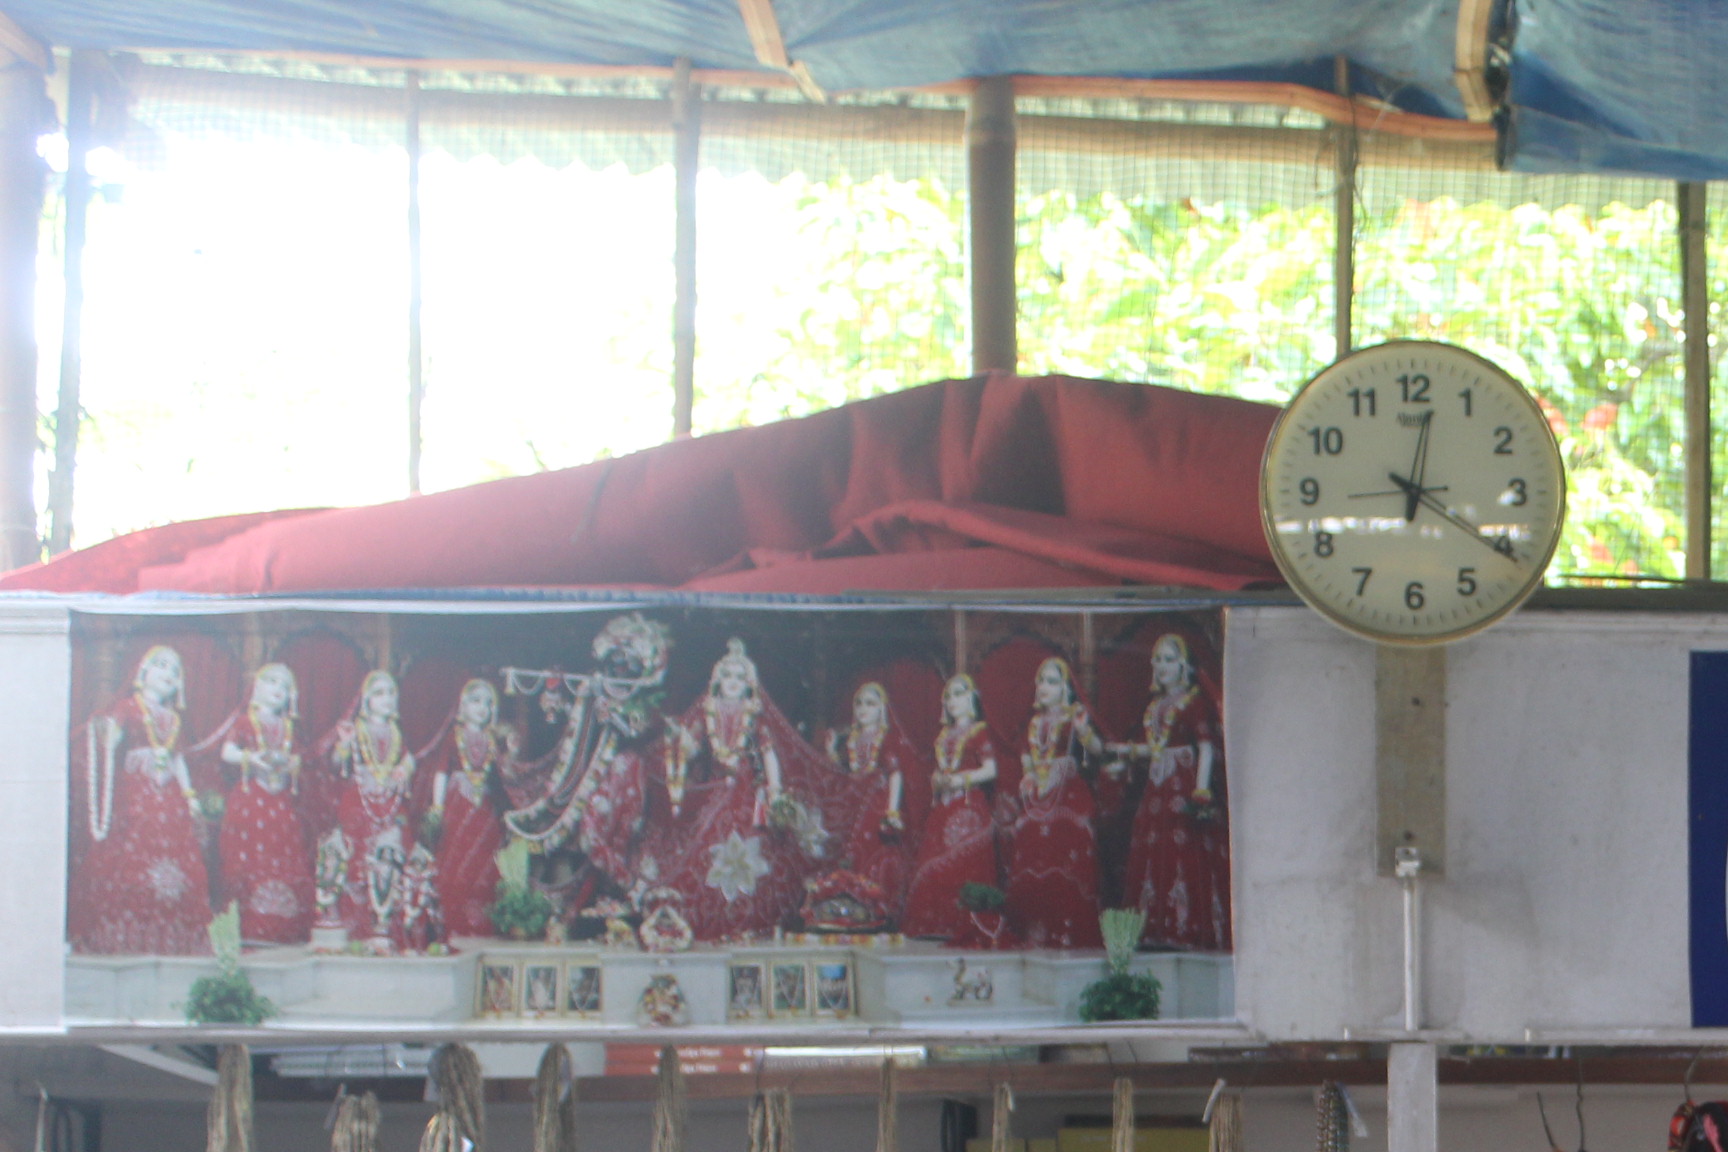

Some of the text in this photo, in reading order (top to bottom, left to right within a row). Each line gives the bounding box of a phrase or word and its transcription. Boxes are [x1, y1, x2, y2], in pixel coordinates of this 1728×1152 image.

[1349, 389, 1376, 417] 11
[1398, 375, 1430, 403] 12
[1460, 389, 1472, 417] 1
[1310, 427, 1344, 455] 10
[1494, 427, 1513, 455] 2
[1300, 478, 1320, 506] 9
[1509, 478, 1528, 507] 3
[1314, 531, 1334, 559] 8
[1353, 568, 1373, 597] 7
[1404, 582, 1425, 611] 6
[1457, 568, 1477, 597] 5
